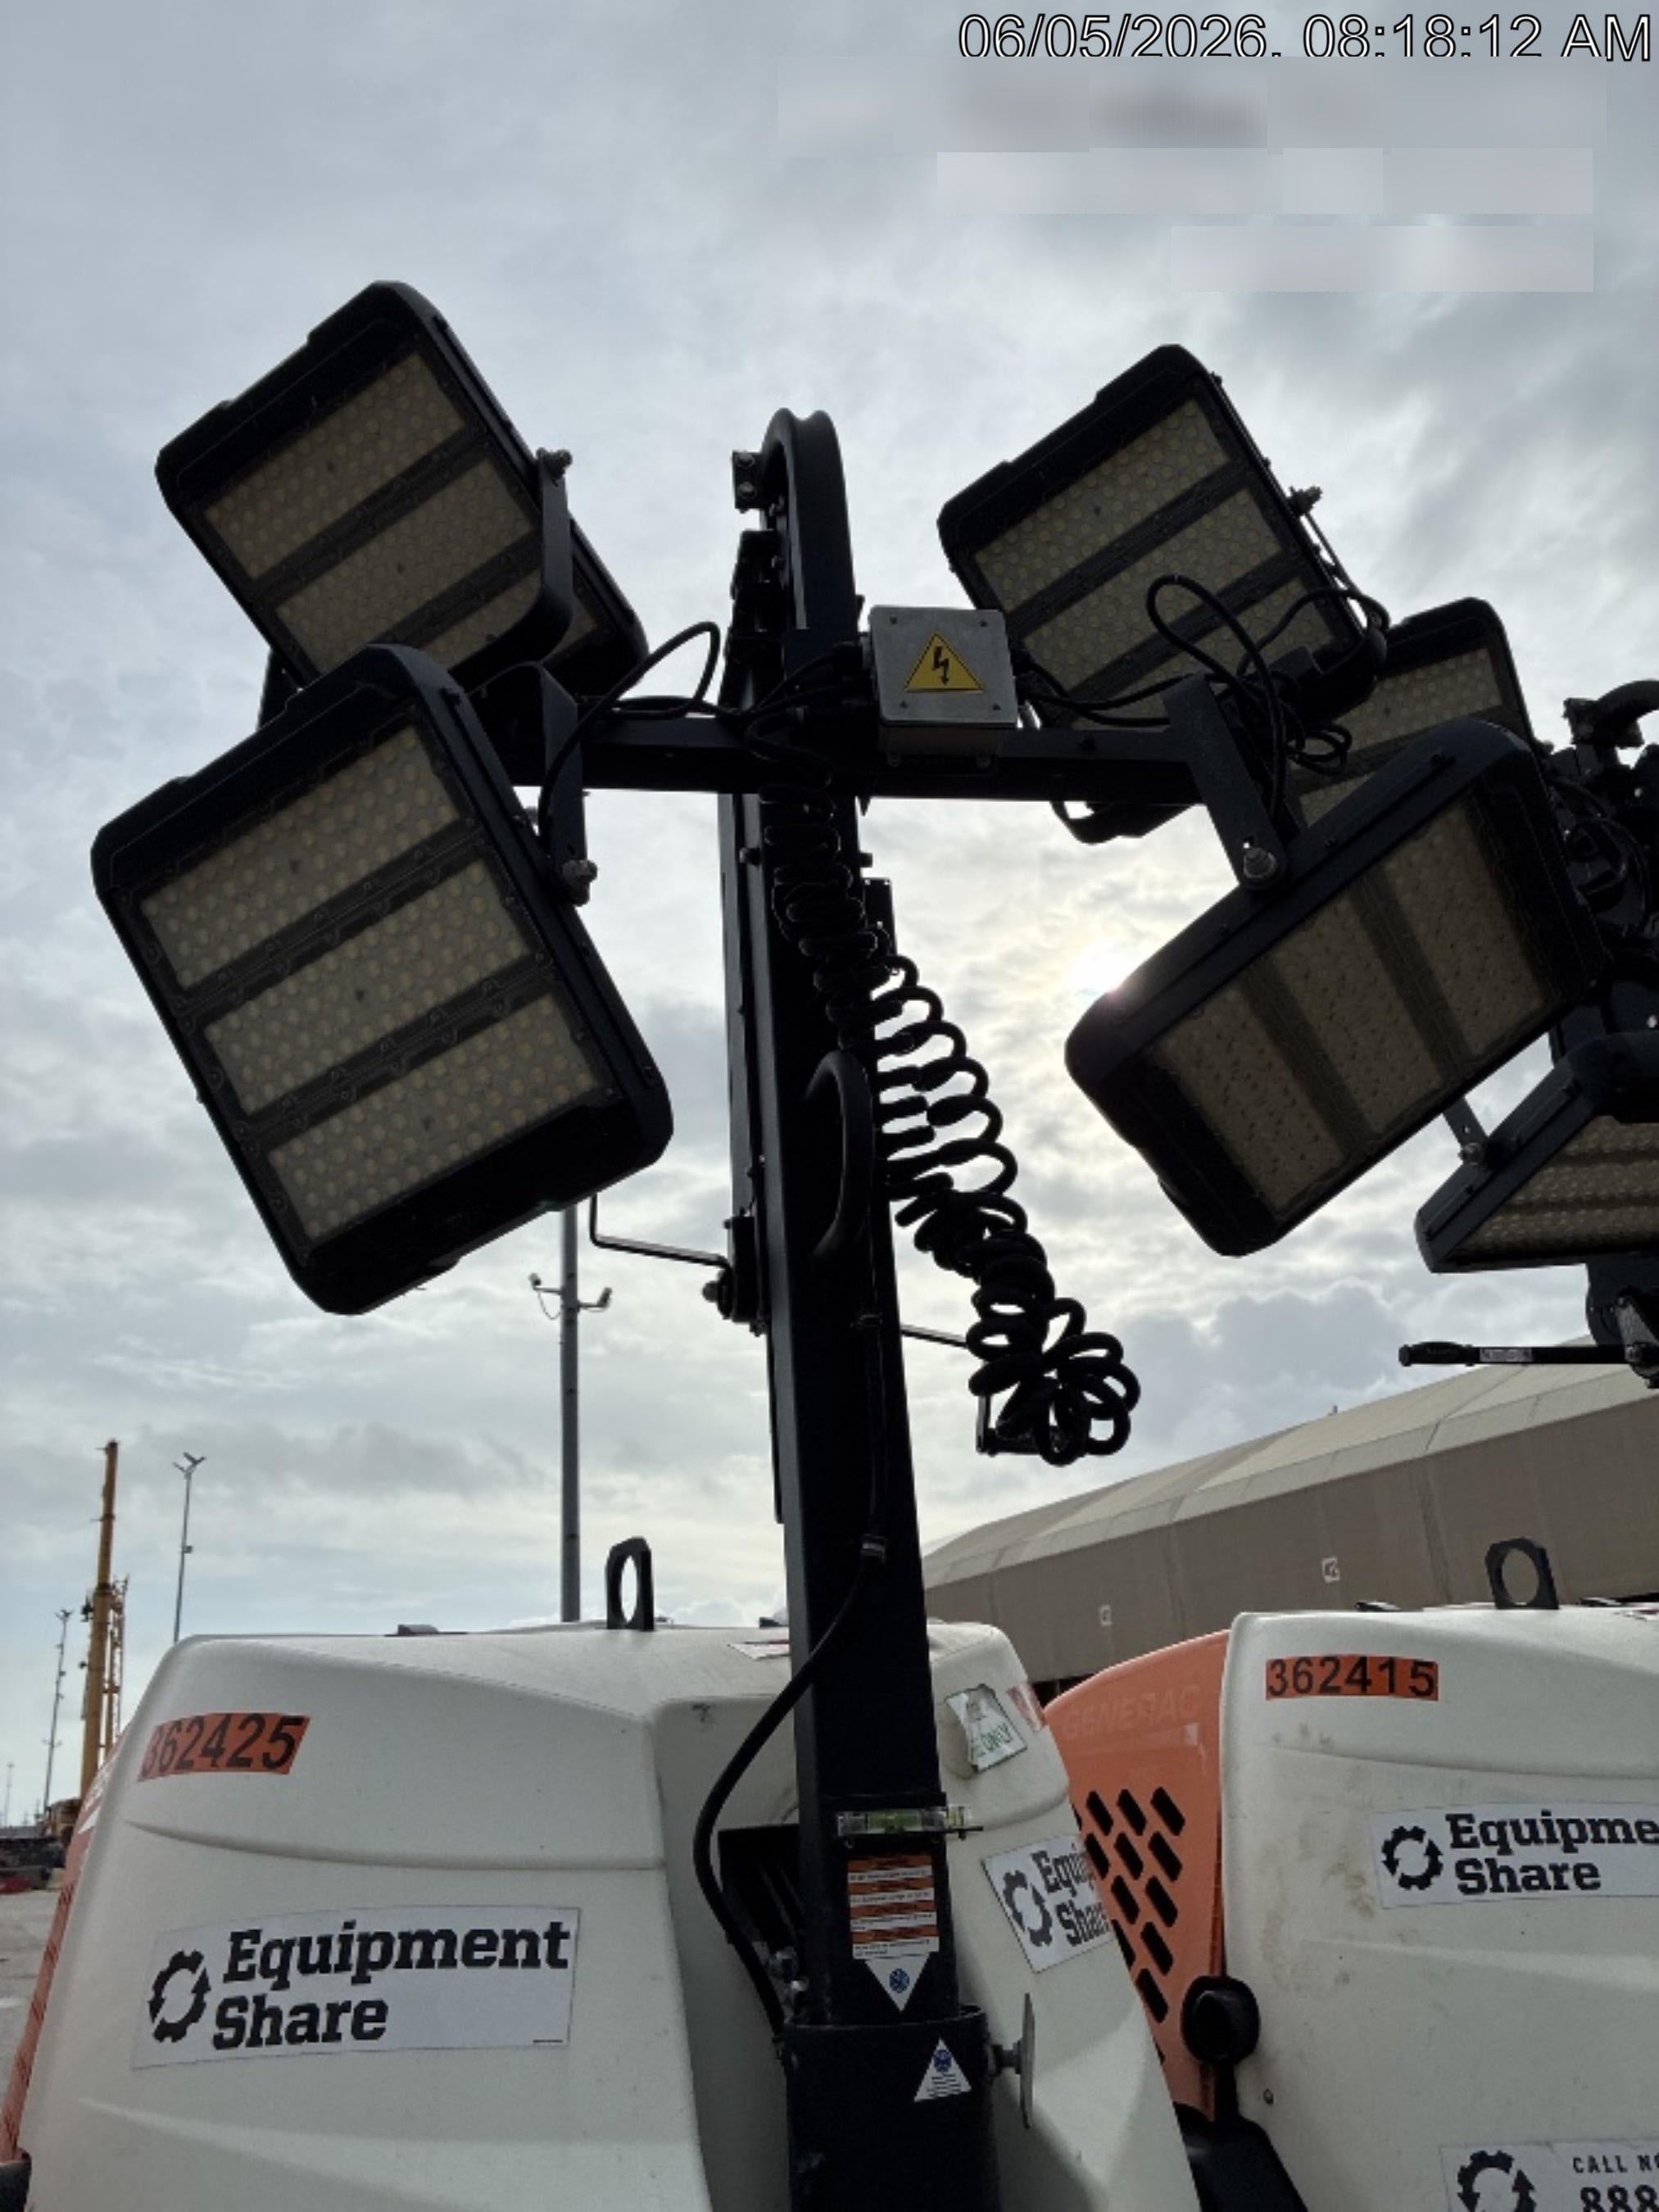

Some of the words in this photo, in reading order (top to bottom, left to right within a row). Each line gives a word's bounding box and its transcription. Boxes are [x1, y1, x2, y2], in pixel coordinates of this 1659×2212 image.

[1268, 1655, 1435, 1697] 362415
[1062, 1684, 1201, 1742] GENERAC
[141, 1713, 306, 1779] 362425
[1454, 1857, 1602, 1896] Share
[223, 1920, 571, 1992] Equipment
[213, 1992, 389, 2050] Share
[1573, 2155, 1629, 2173] CALL
